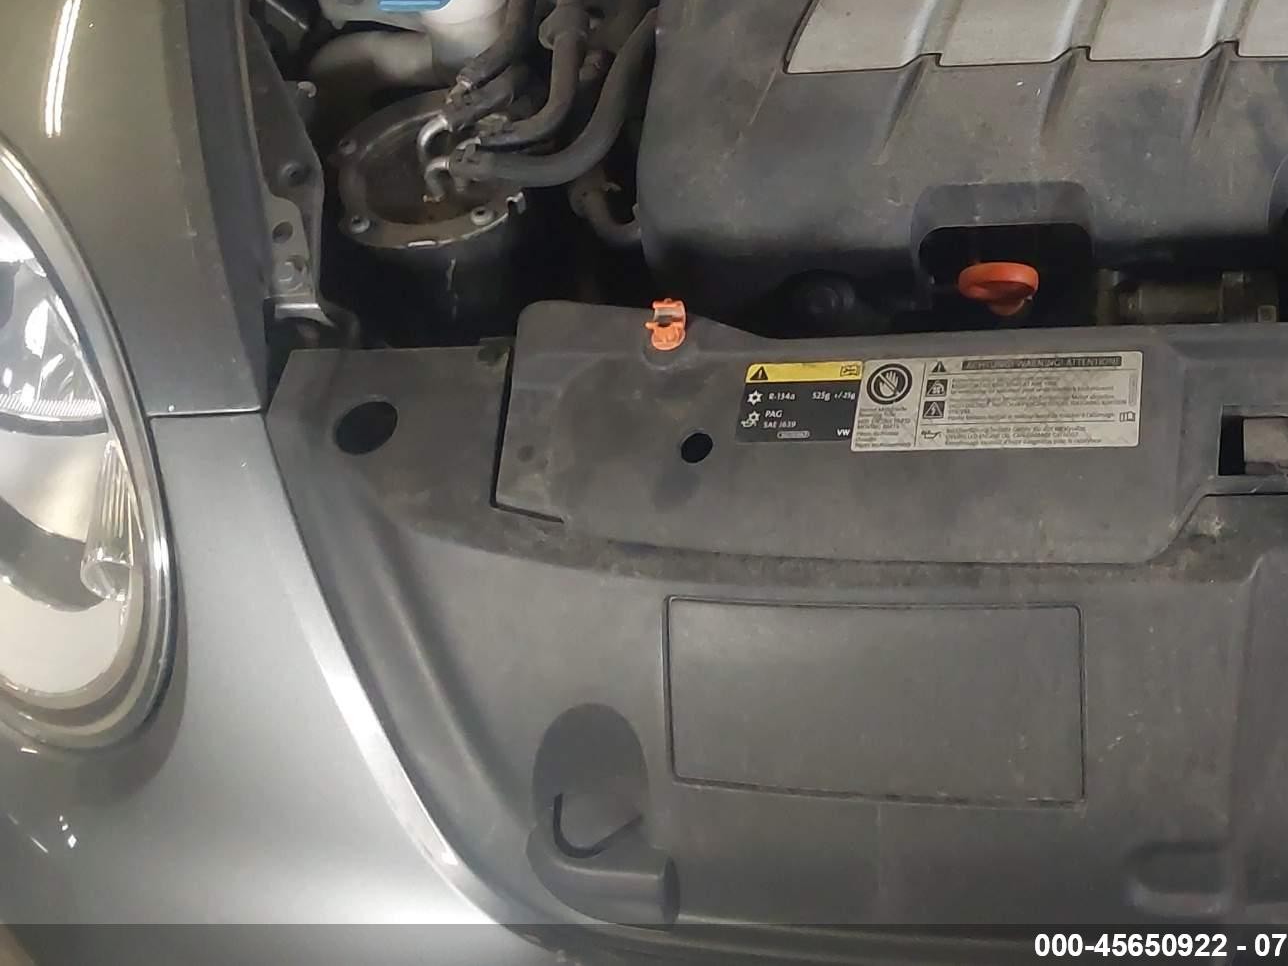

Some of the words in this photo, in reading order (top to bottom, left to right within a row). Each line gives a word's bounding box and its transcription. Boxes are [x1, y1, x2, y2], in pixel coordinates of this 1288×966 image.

[765, 409, 783, 418] PAG
[763, 420, 777, 429] SAE
[837, 428, 851, 436] VW
